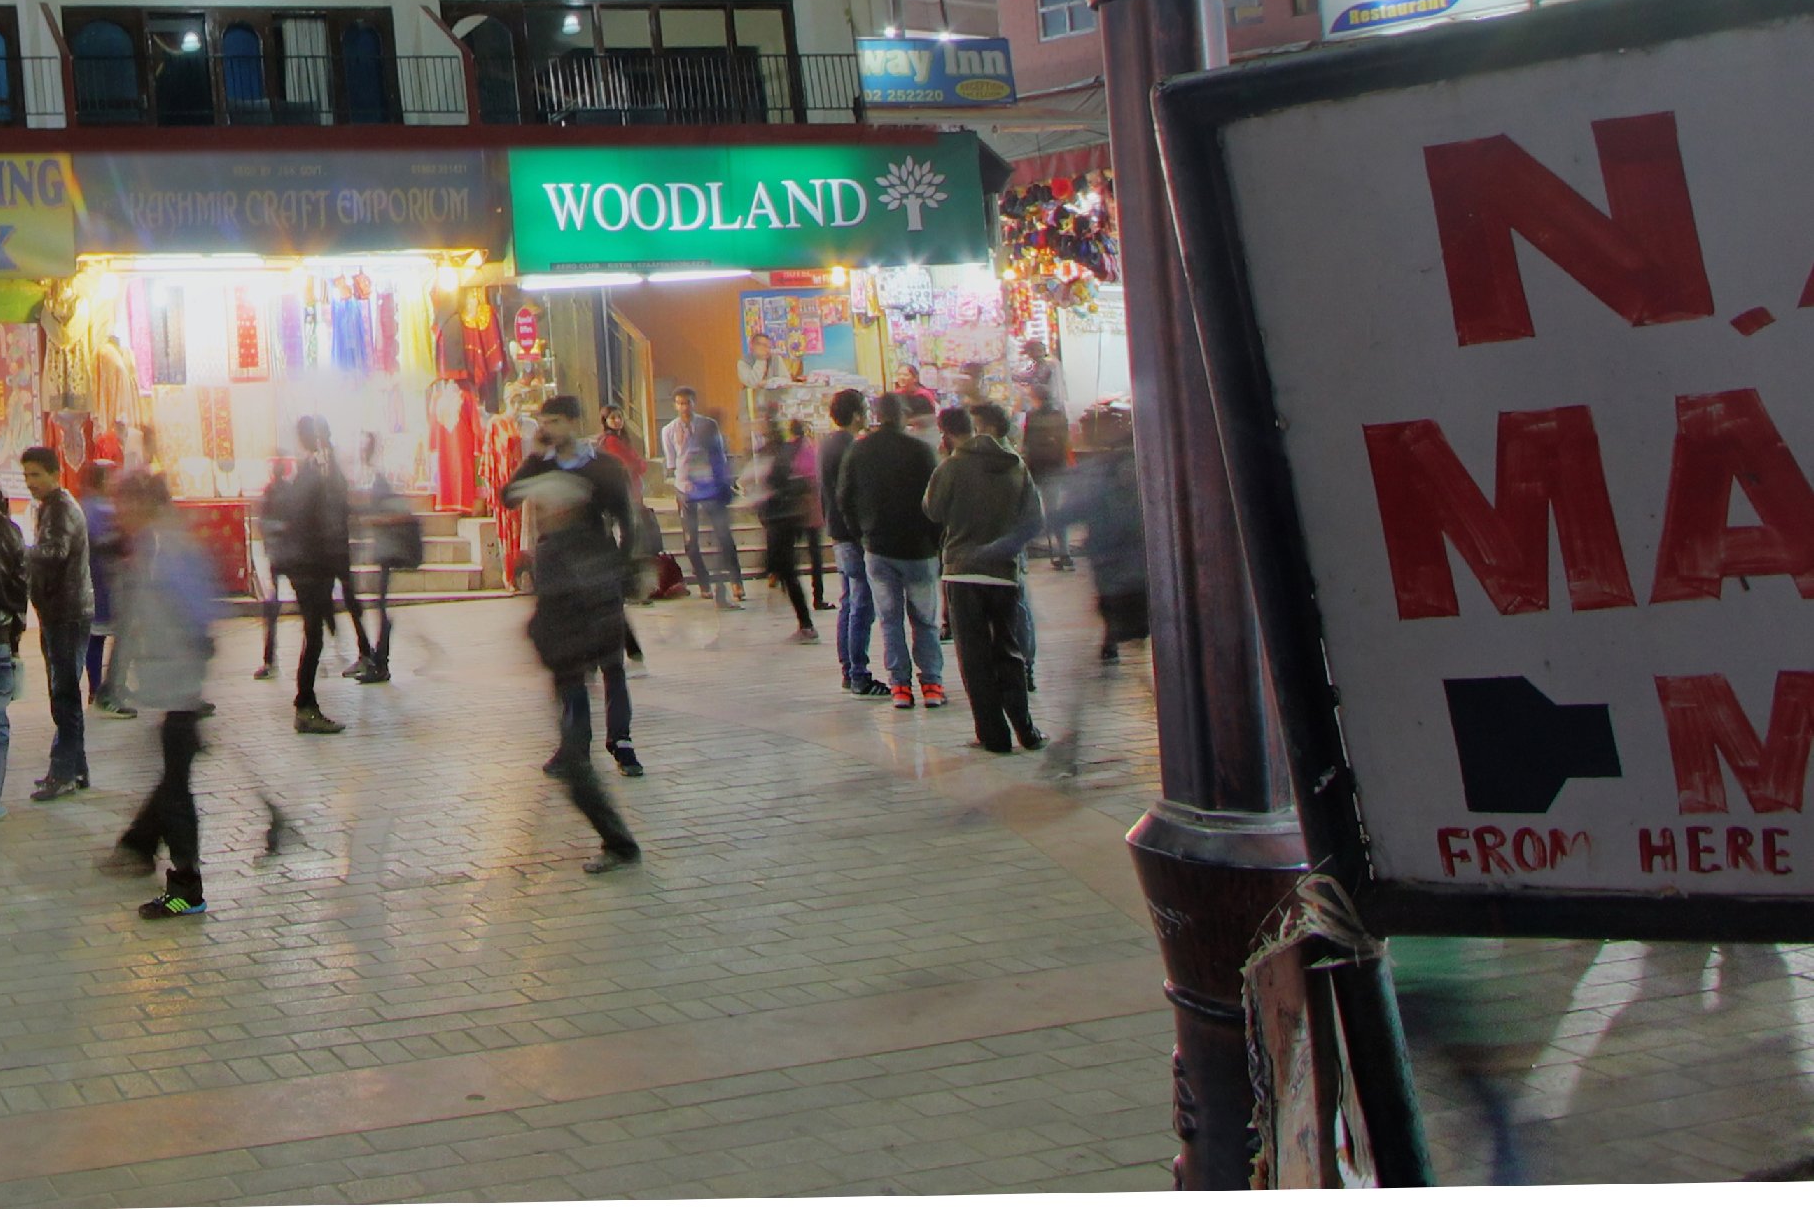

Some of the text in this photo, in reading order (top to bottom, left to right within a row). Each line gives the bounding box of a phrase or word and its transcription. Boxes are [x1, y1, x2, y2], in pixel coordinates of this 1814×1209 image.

[859, 44, 1008, 84] way Inn
[887, 90, 944, 102] 252220
[130, 187, 470, 232] KASHMIR CRAFT EMPORIUM
[542, 178, 870, 231] WOODLAND
[1437, 826, 1792, 877] FROM HERE
